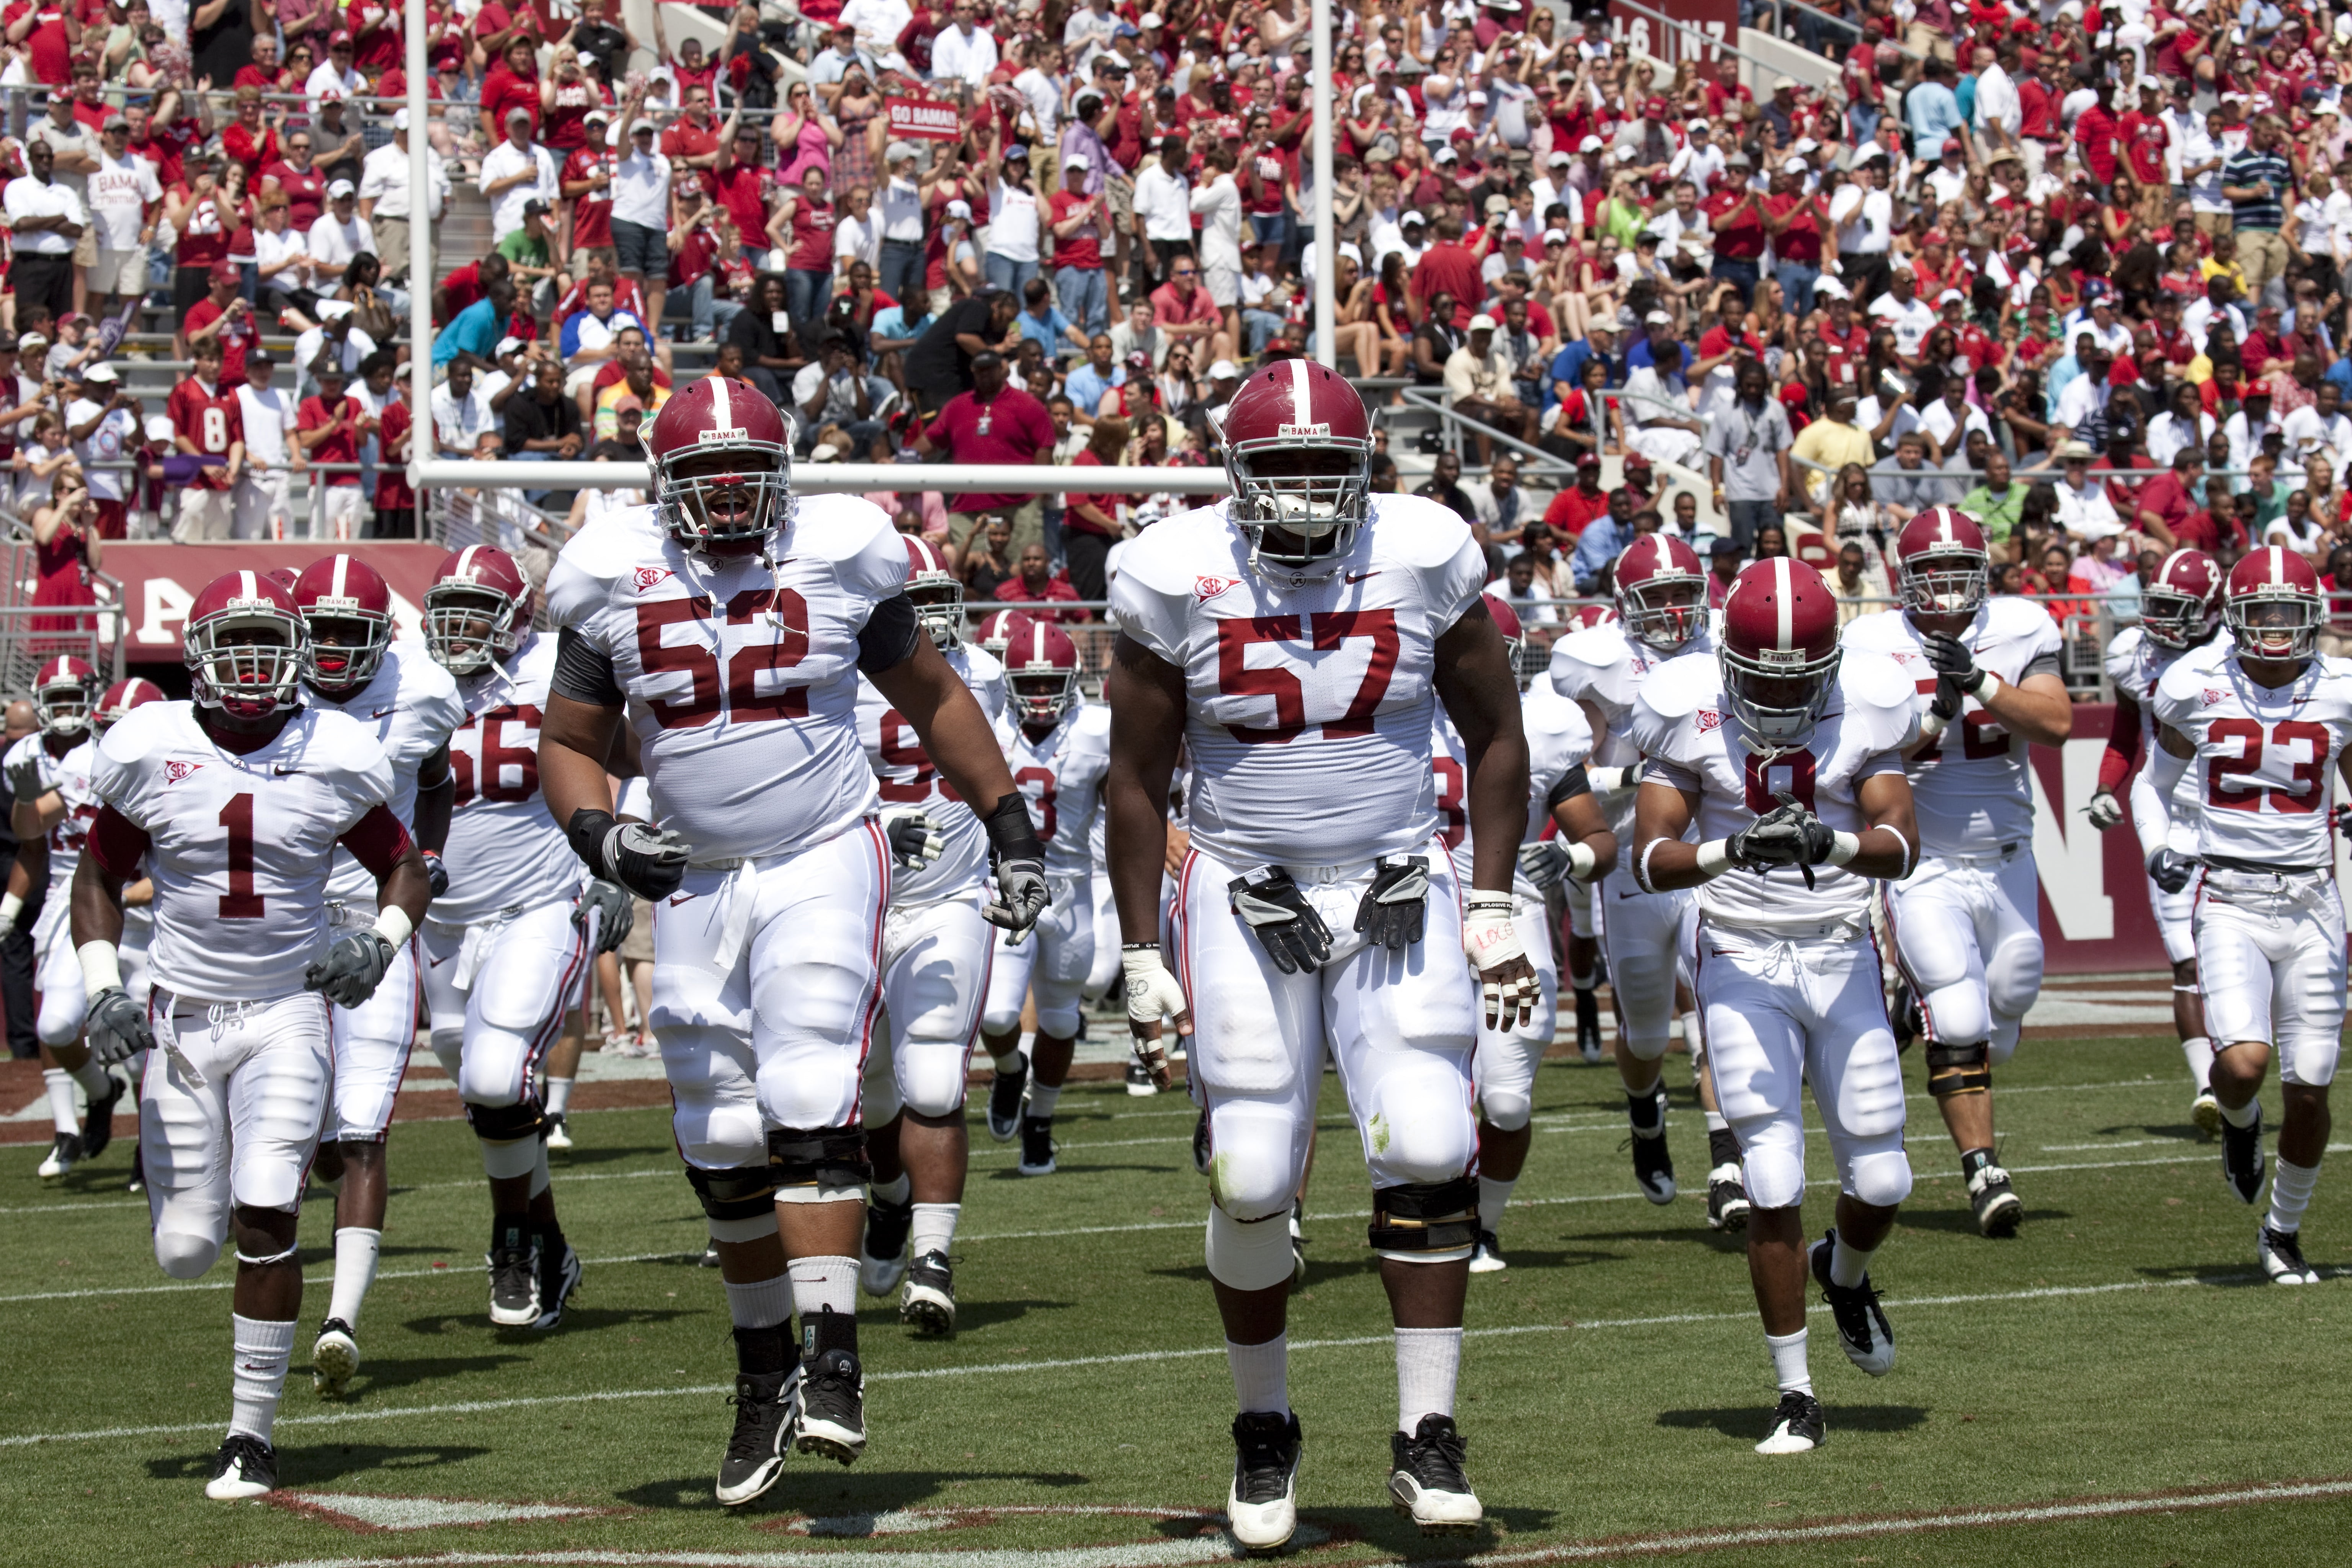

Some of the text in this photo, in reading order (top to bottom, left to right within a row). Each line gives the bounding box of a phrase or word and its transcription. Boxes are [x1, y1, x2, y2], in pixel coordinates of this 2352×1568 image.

[1681, 20, 1726, 62] N-7
[891, 105, 958, 127] GO BAMA!!
[99, 174, 141, 193] BAMA
[188, 200, 222, 235] 12
[203, 407, 228, 453] 8
[711, 431, 737, 440] BAMA
[1291, 427, 1318, 435] BAMA
[641, 568, 658, 585] SEC
[1202, 579, 1222, 595] SEC
[637, 588, 810, 729] 52
[1770, 654, 1795, 663] BAMA
[1218, 608, 1401, 744] 57
[2206, 691, 2220, 702] SEC
[1702, 712, 1720, 727] SEC
[171, 763, 187, 777] SEC
[2208, 718, 2330, 814] 23
[219, 792, 265, 918] 1
[1476, 922, 1513, 949] LOCO
